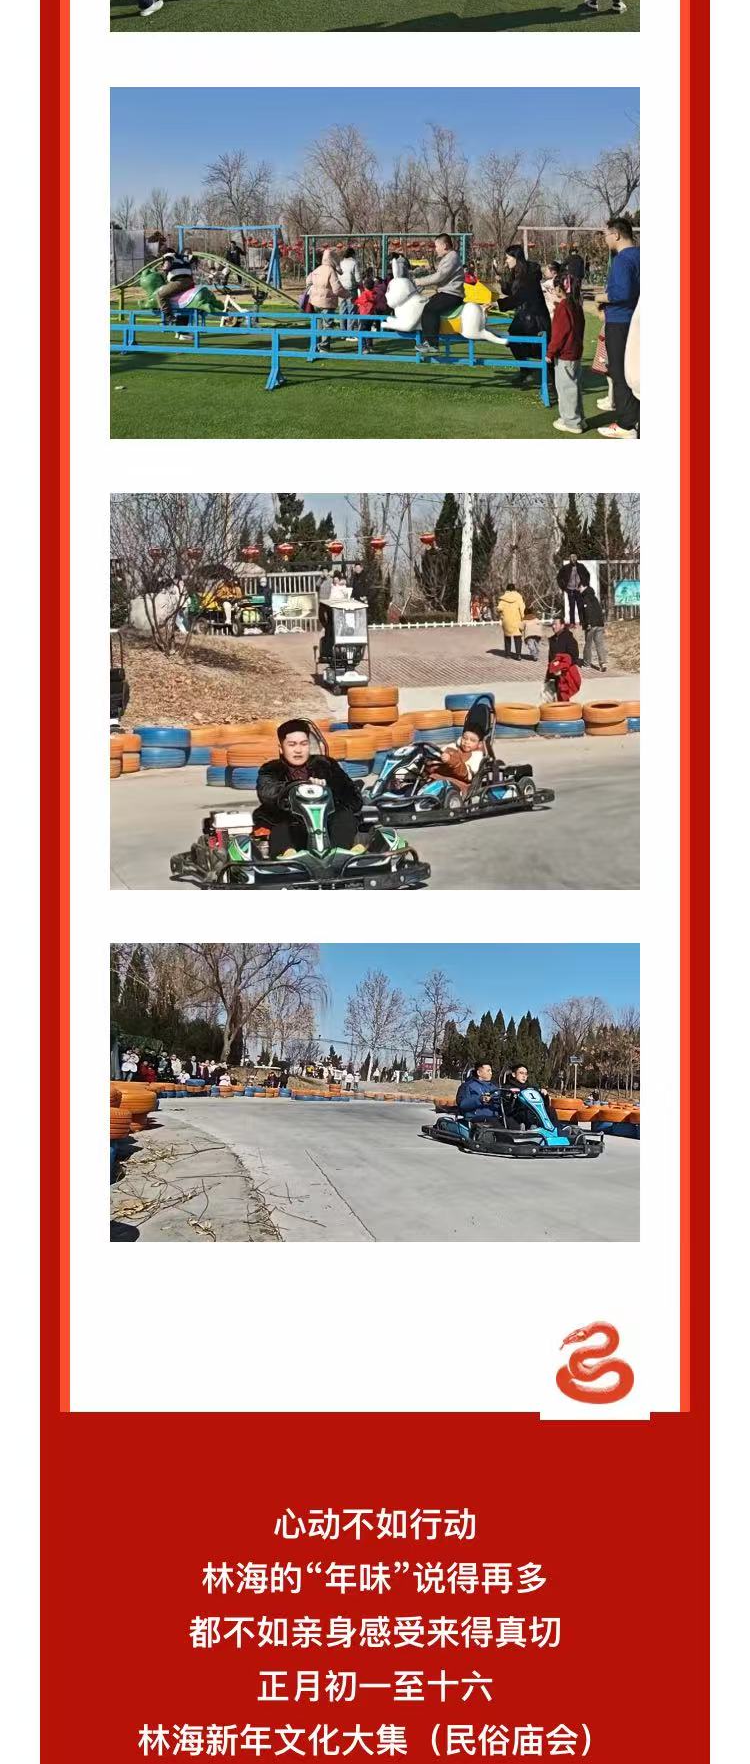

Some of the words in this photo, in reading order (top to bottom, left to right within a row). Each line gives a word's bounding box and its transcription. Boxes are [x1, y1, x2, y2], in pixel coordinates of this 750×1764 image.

[273, 1507, 477, 1542] 心动不如行动
[201, 1560, 547, 1595] 林海的“年味”说得再多
[188, 1615, 561, 1649] 都不如亲身感受来得真切
[256, 1669, 494, 1703] 正月初一至十六
[137, 1722, 592, 1757] 林海新年文化大集（民俗庙会）
